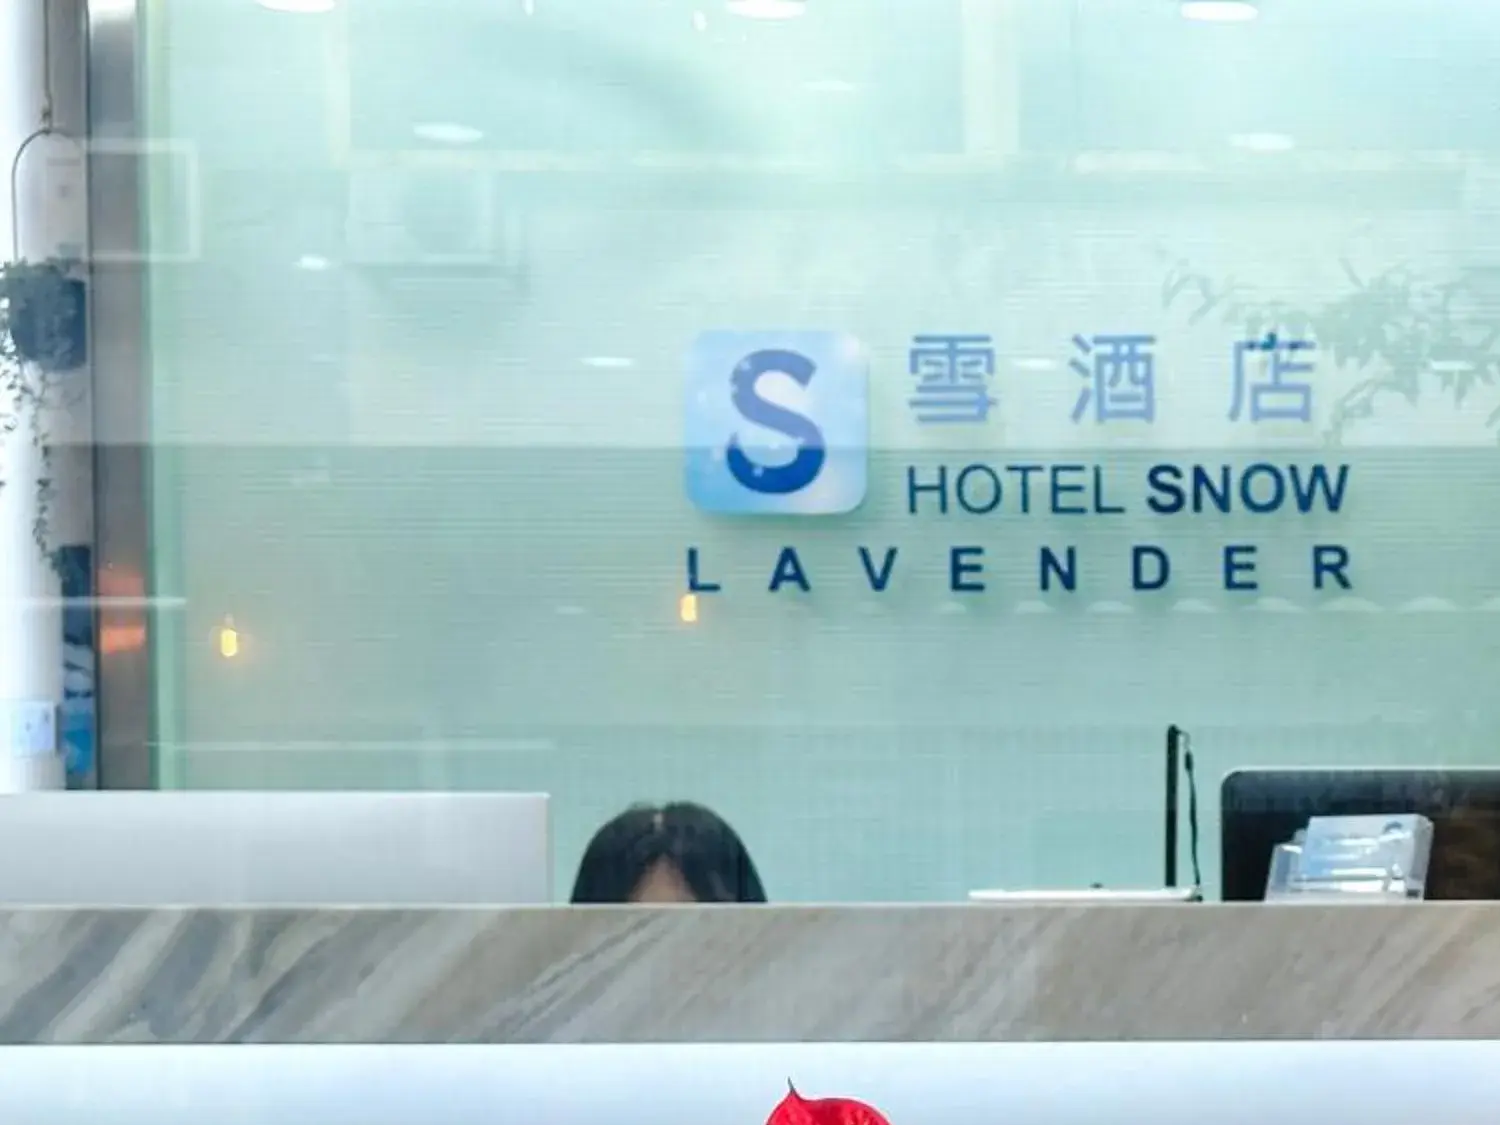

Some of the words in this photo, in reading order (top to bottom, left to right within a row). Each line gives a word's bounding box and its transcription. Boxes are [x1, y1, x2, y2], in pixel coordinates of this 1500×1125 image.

[907, 333, 1317, 425] 雪酒店
[725, 348, 826, 494] S
[907, 464, 1125, 515] HOTEL
[1146, 464, 1350, 514] SNOW
[686, 546, 1353, 593] LAVENDER
